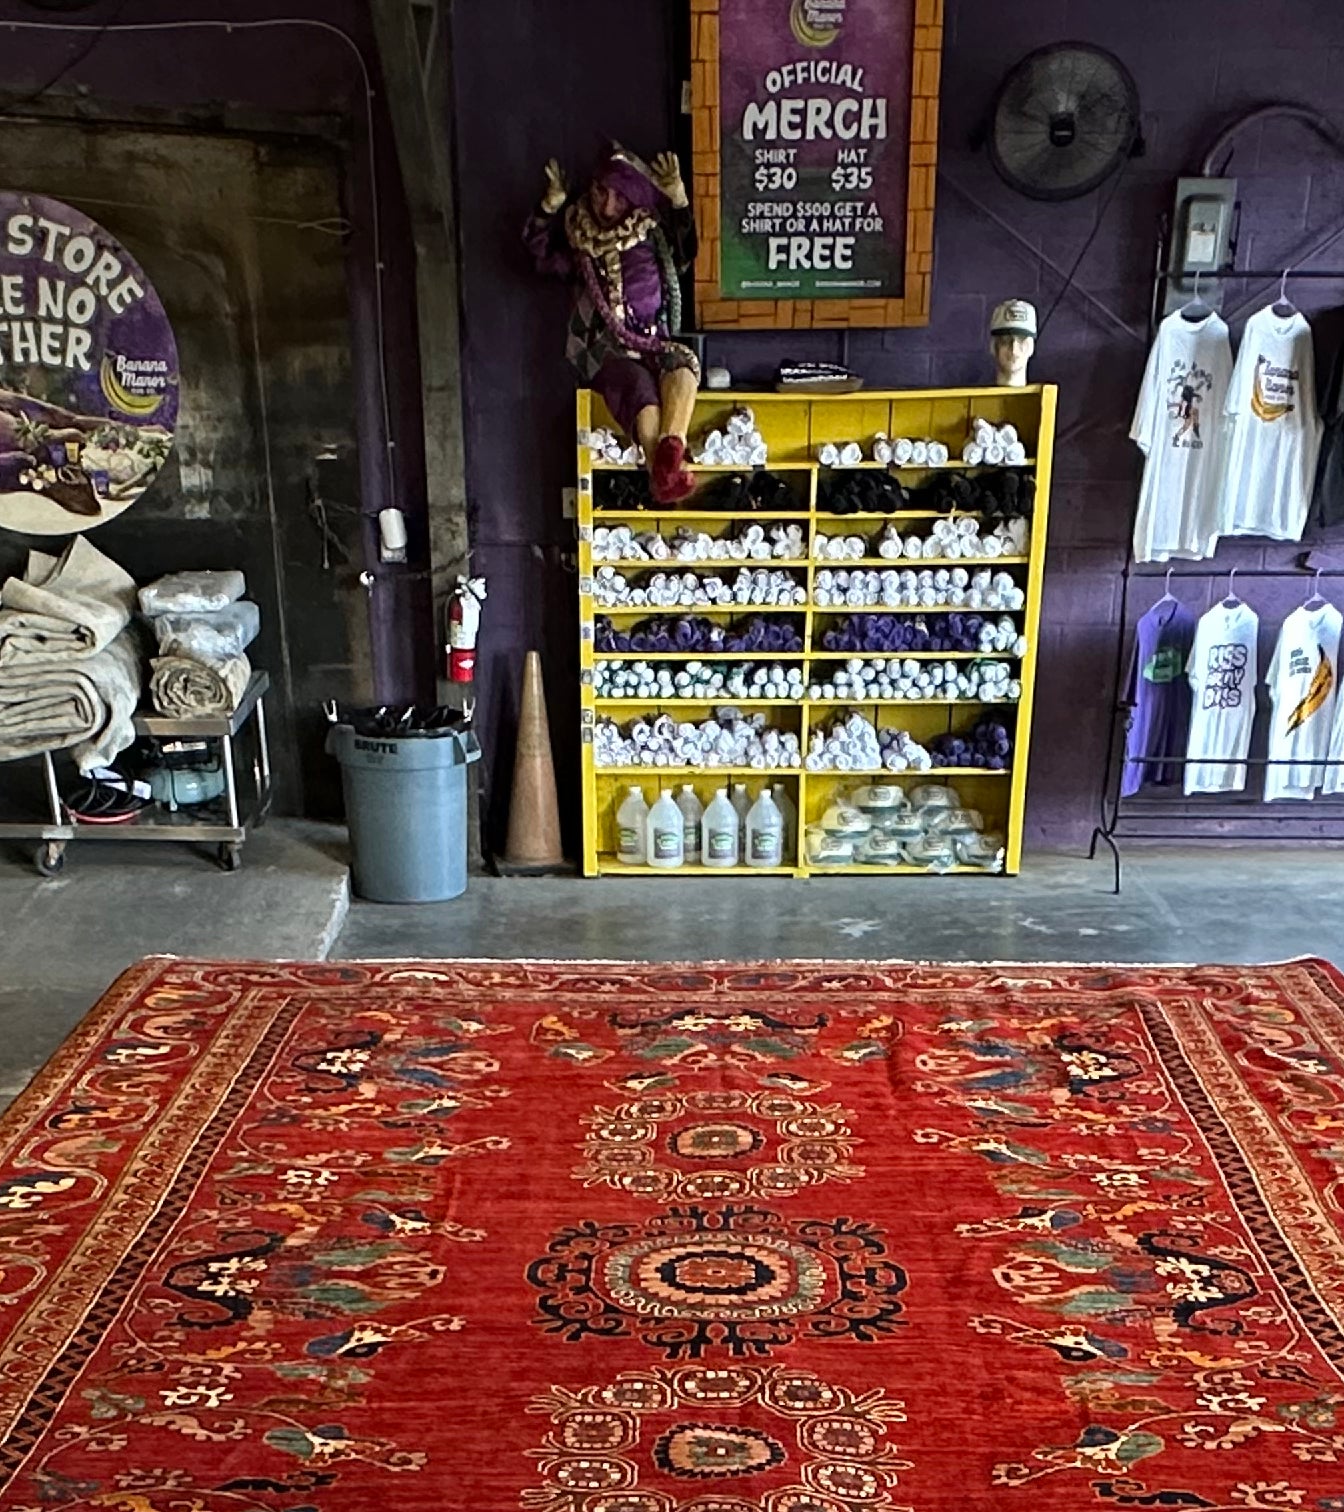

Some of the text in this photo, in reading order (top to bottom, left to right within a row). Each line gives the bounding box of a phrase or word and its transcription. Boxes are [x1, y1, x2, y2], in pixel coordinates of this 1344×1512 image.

[765, 60, 864, 94] OFFICIAL
[742, 98, 887, 140] MERCH
[755, 149, 797, 164] SHIRT
[837, 148, 868, 163] HAT
[754, 166, 798, 191] $30
[831, 166, 873, 191] $35
[747, 202, 878, 216] SPEND $500 GET A
[741, 217, 883, 233] SHIRT OR A HAT FOR
[768, 236, 856, 270] FREE
[8, 213, 145, 315] STORE
[38, 277, 96, 325] NO
[117, 355, 167, 371] Banana
[121, 372, 165, 387] Manor
[355, 739, 398, 755] BRUTE
